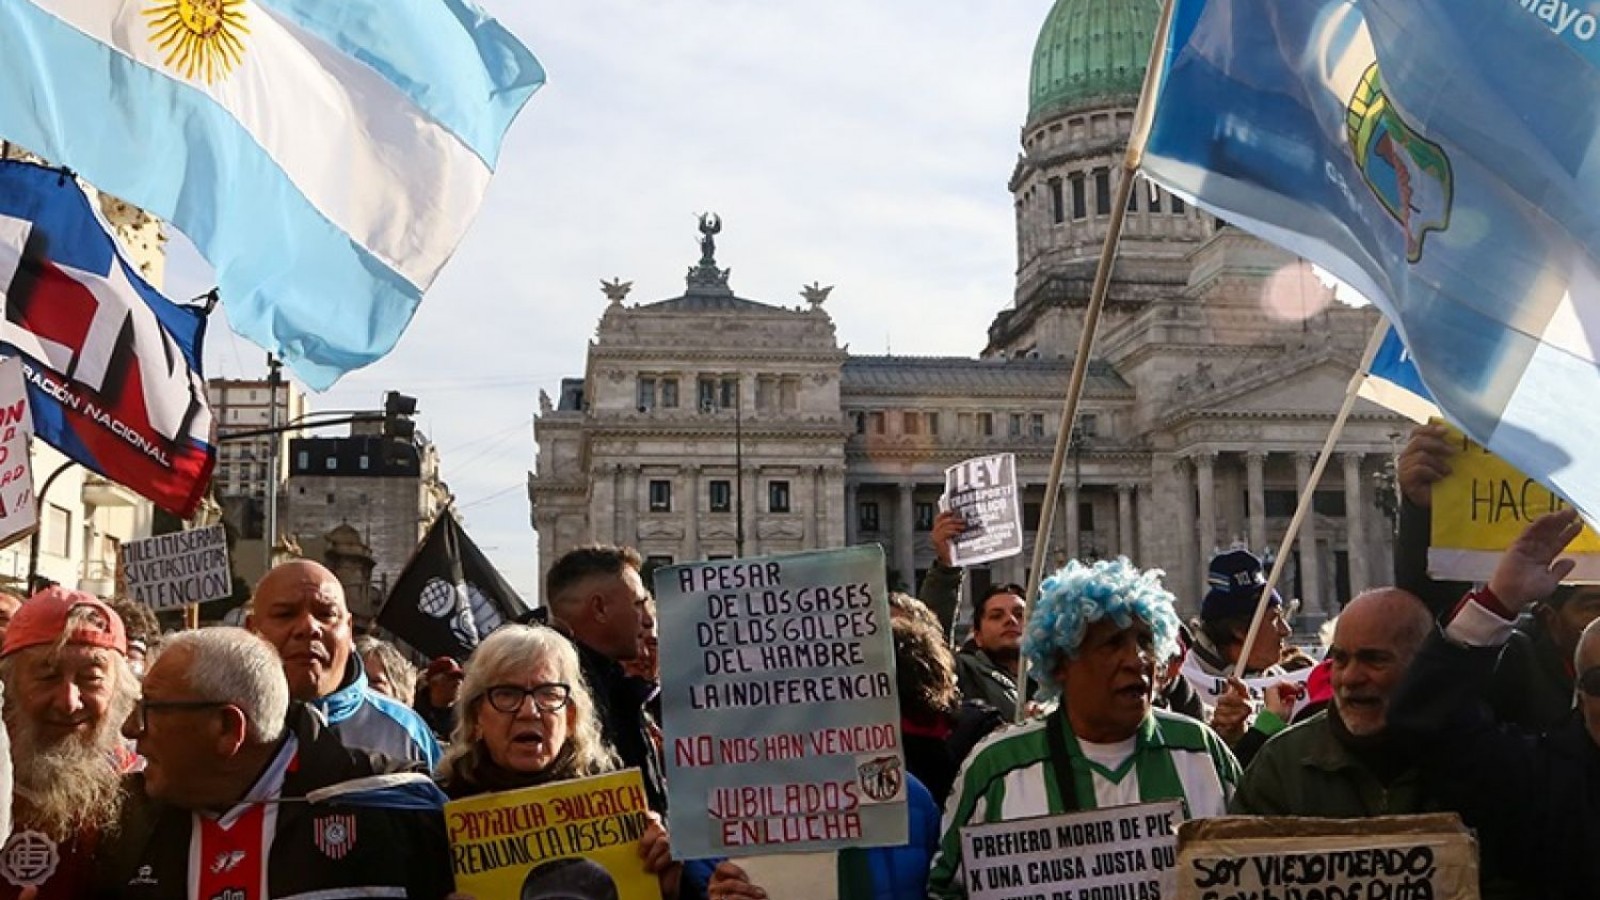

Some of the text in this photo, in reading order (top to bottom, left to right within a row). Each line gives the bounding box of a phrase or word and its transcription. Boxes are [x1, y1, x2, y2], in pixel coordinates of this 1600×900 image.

[83, 402, 171, 467] NACIONAL
[957, 456, 1003, 494] LEY
[135, 569, 228, 609] ATENCION
[679, 562, 781, 593] A PESAR
[708, 583, 872, 620] DE LOS GASES
[697, 611, 877, 648] DE LOS GOLPES
[705, 642, 864, 675] DEL HAMBRE
[689, 672, 891, 709] LA INDIFERENCIA
[675, 724, 897, 767] NO NOS HAN VENCIDO
[450, 784, 646, 844] PATRICIA BULLRICH
[708, 781, 860, 820] JUBILADOS
[722, 813, 863, 846] EN LUCHA
[1056, 820, 1115, 849] MORIR
[1119, 816, 1141, 840] DE
[452, 826, 565, 876] RENUNCIA
[970, 870, 983, 893] X
[987, 864, 1023, 890] UNA
[1027, 856, 1087, 886] CAUSA
[1091, 848, 1147, 878] JUSTA
[1193, 856, 1247, 887] SOY
